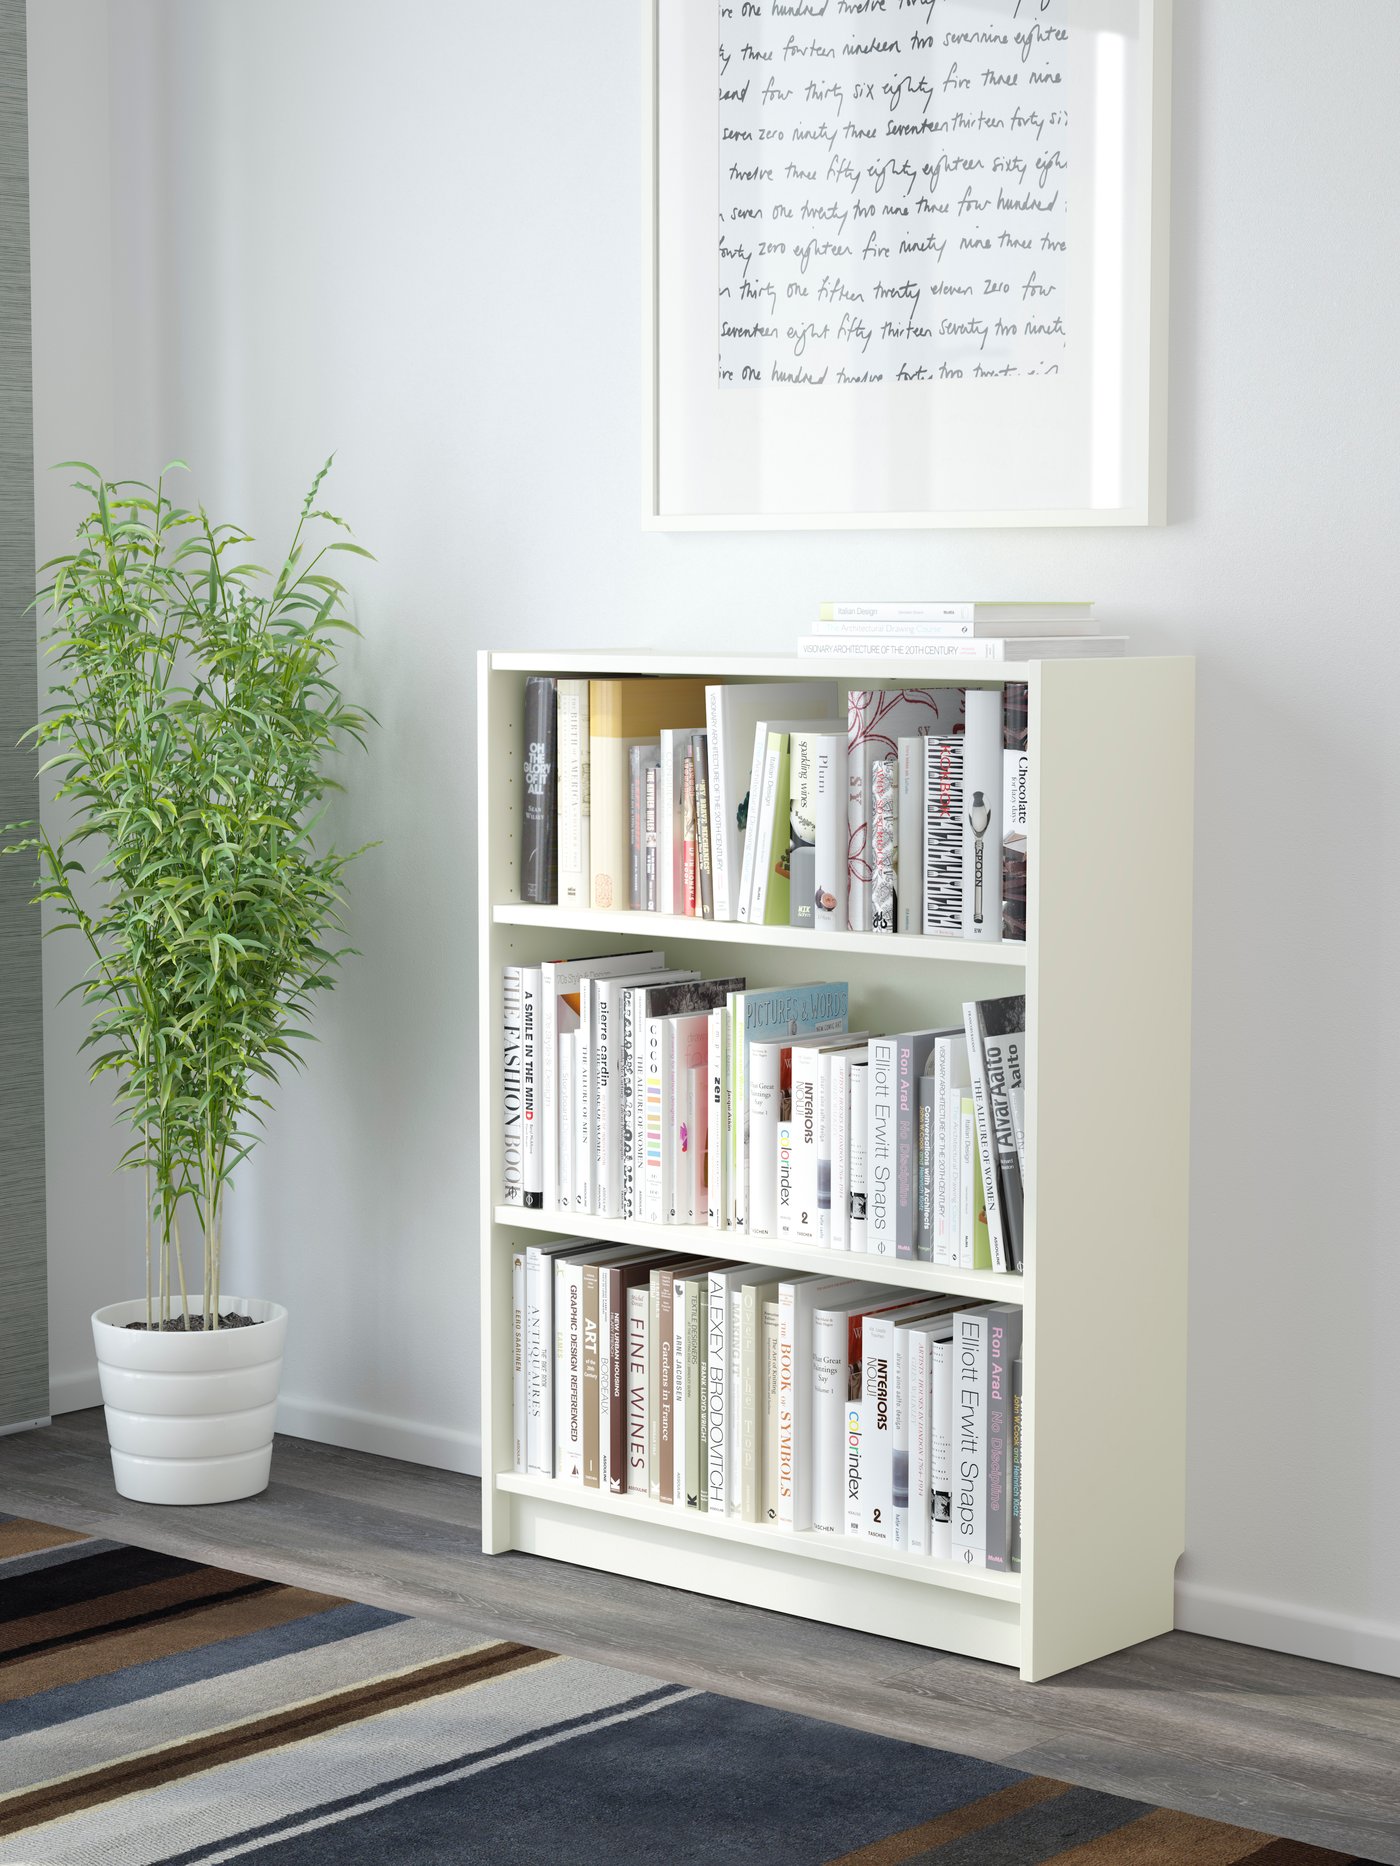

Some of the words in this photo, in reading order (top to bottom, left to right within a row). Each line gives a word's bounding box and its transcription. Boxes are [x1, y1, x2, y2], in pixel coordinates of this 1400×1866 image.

[741, 2, 762, 17] one
[741, 43, 773, 61] three
[842, 34, 902, 56] nineteen
[911, 30, 934, 50] two
[804, 80, 844, 118] thirty
[853, 82, 875, 101] six
[882, 73, 934, 114] eighty
[981, 69, 1018, 87] three
[1028, 62, 1063, 85] nine
[722, 128, 753, 142] seven
[758, 129, 785, 141] zero
[791, 121, 839, 153] ninety
[843, 121, 877, 140] three
[951, 110, 1005, 131] thirteen
[1010, 106, 1045, 142] forty
[729, 162, 774, 182] twelve
[784, 161, 817, 181] three
[826, 154, 862, 195] fifty
[867, 158, 917, 196] eighty
[922, 149, 985, 194] eighteen
[992, 156, 1027, 185] sixty
[730, 207, 763, 221] seven
[772, 204, 794, 220] one
[800, 200, 849, 237] twenty
[853, 199, 876, 221] two
[882, 194, 909, 217] nine
[915, 196, 950, 214] three
[996, 186, 1059, 213] hundred
[758, 242, 786, 256] zero
[793, 226, 853, 275] eighteen
[898, 231, 948, 265] ninety
[959, 225, 992, 250] nine
[998, 230, 1033, 250] three
[739, 279, 777, 316] thirty
[786, 282, 809, 299] one
[817, 275, 865, 303] fifteen
[872, 280, 921, 321] twenty
[930, 280, 974, 296] eleven
[983, 279, 1010, 295] zero
[786, 321, 831, 357] eight
[837, 312, 873, 354] fifty
[880, 321, 933, 340] thirteen
[938, 317, 989, 351] seventy
[994, 317, 1018, 336] two
[741, 365, 762, 382] one
[771, 360, 829, 385] hundred
[938, 361, 964, 379] two
[837, 607, 856, 616] Italian
[856, 607, 878, 617] Design
[803, 644, 833, 655] VISIONARY
[833, 644, 881, 655] ARCHITECTURE
[880, 644, 890, 655] OF
[890, 644, 904, 656] THE
[905, 644, 924, 656] 20TH
[924, 645, 958, 656] CENTURY
[524, 762, 551, 774] GLORY
[529, 752, 546, 764] THE
[530, 743, 545, 753] OH
[800, 740, 808, 780] sparkling
[526, 773, 538, 785] OF
[537, 773, 547, 785] IT
[528, 784, 544, 795] ALL
[818, 755, 829, 793] Plum
[940, 745, 951, 817] KOKBOK
[1018, 756, 1028, 824] Chocolate
[975, 848, 983, 888] SPOON
[504, 971, 521, 1019] THE
[524, 991, 533, 1000] A
[747, 994, 798, 1030] PICTURES
[801, 1005, 808, 1021] &
[809, 991, 848, 1018] WORDS
[525, 1004, 533, 1041] SMILE
[601, 1002, 609, 1041] pierre
[525, 1044, 533, 1058] IN
[525, 1061, 533, 1084] THE
[601, 1044, 609, 1087] cardin
[875, 1045, 891, 1098] Elliott
[901, 1048, 910, 1075] Ron
[987, 1046, 1006, 1098] Aalto
[504, 1025, 521, 1126] FASHION
[901, 1079, 910, 1111] Arad
[975, 1079, 983, 1100] THE
[525, 1086, 534, 1121] MIND
[795, 1081, 804, 1115] NOW!
[804, 1081, 813, 1144] INTERIORS
[875, 1105, 891, 1160] Erwitt
[977, 1101, 989, 1146] ALLURE
[993, 1096, 1014, 1148] Alvar
[504, 1134, 521, 1199] BOOK
[780, 1128, 792, 1206] colorindex
[982, 1146, 990, 1161] OF
[874, 1167, 891, 1230] Snaps
[985, 1165, 996, 1211] WOMEN
[801, 1211, 808, 1224] 2
[585, 1317, 597, 1354] ART
[710, 1279, 724, 1361] ALEXEY
[992, 1327, 1003, 1357] Ron
[531, 1306, 540, 1417] ANTIQUAIRES
[631, 1318, 645, 1374] FINE
[662, 1341, 670, 1387] Gardens
[781, 1343, 791, 1391] BOOK
[822, 1356, 842, 1365] Great
[961, 1321, 980, 1383] Elliott
[601, 1357, 609, 1415] BORDEAUX
[662, 1390, 670, 1401] in
[817, 1374, 828, 1384] Say
[867, 1356, 876, 1397] NOW!
[877, 1358, 888, 1431] INTERIORS
[991, 1360, 1003, 1400] Arad
[570, 1375, 578, 1442] REFERENCED
[631, 1387, 645, 1469] WINES
[662, 1404, 670, 1441] France
[961, 1390, 979, 1454] Erwitt
[991, 1411, 1002, 1433] No
[709, 1366, 724, 1502] BRODOVITCH
[781, 1411, 792, 1498] SYMBOLS
[849, 1410, 862, 1500] colorindex
[990, 1437, 1003, 1511] Discipline
[873, 1508, 882, 1524] 2
[960, 1462, 979, 1536] Snaps
